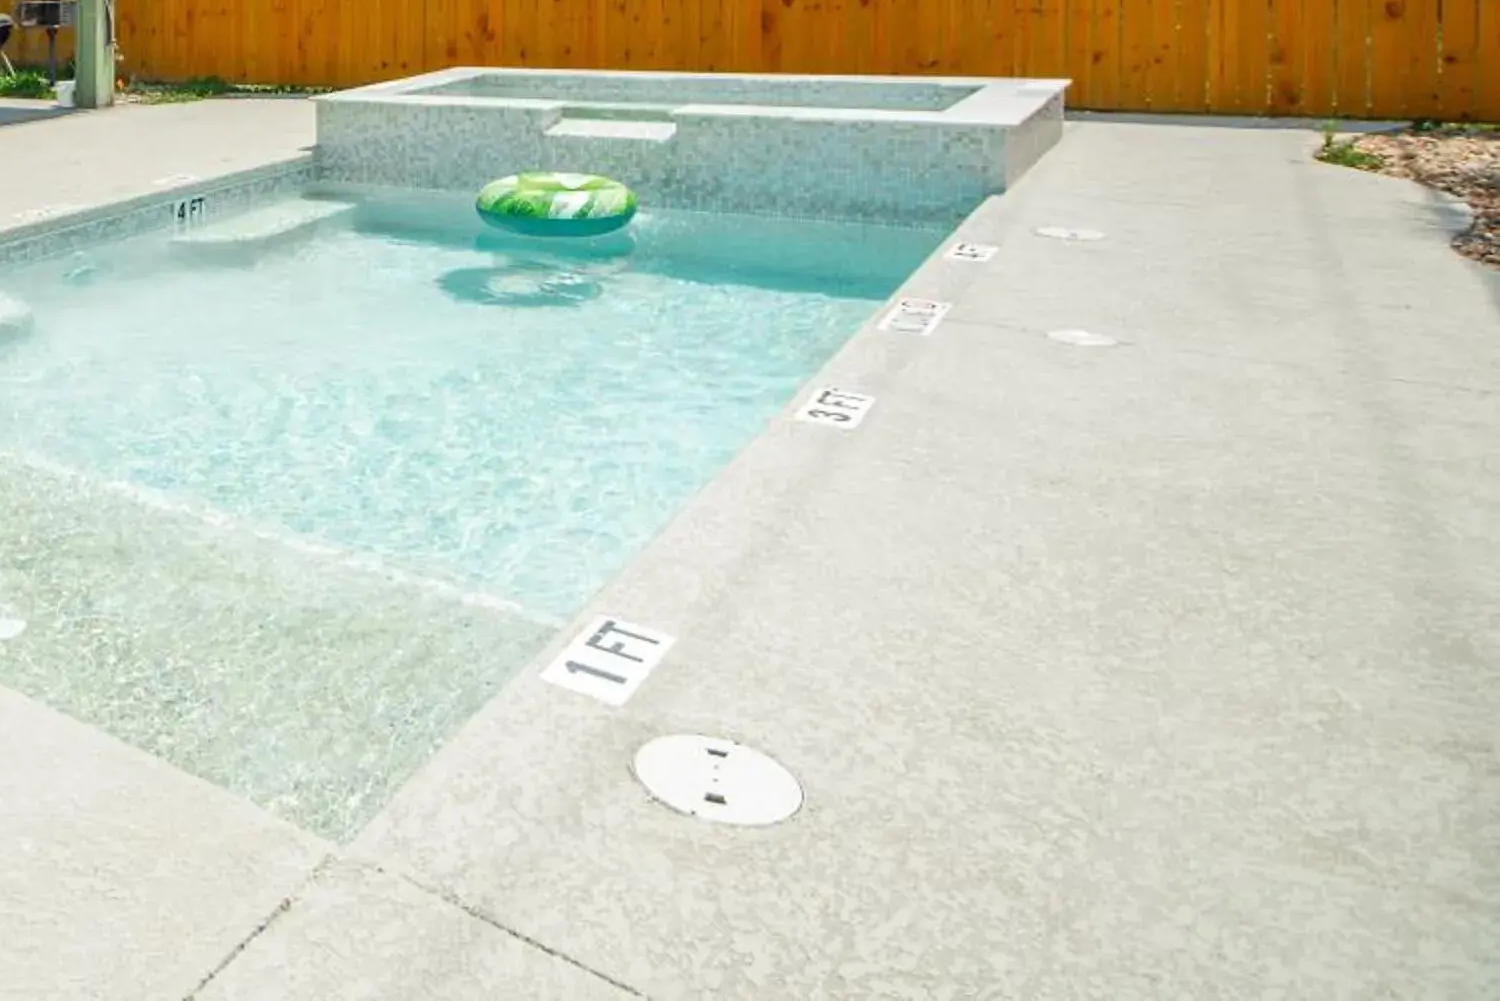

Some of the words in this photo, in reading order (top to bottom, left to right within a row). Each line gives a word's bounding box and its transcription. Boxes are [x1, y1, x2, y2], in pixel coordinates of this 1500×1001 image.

[177, 201, 186, 220] 4
[190, 197, 205, 218] FT
[817, 388, 867, 411] FT
[808, 408, 852, 422] 3
[585, 620, 660, 663] FT
[564, 660, 628, 685] 1
